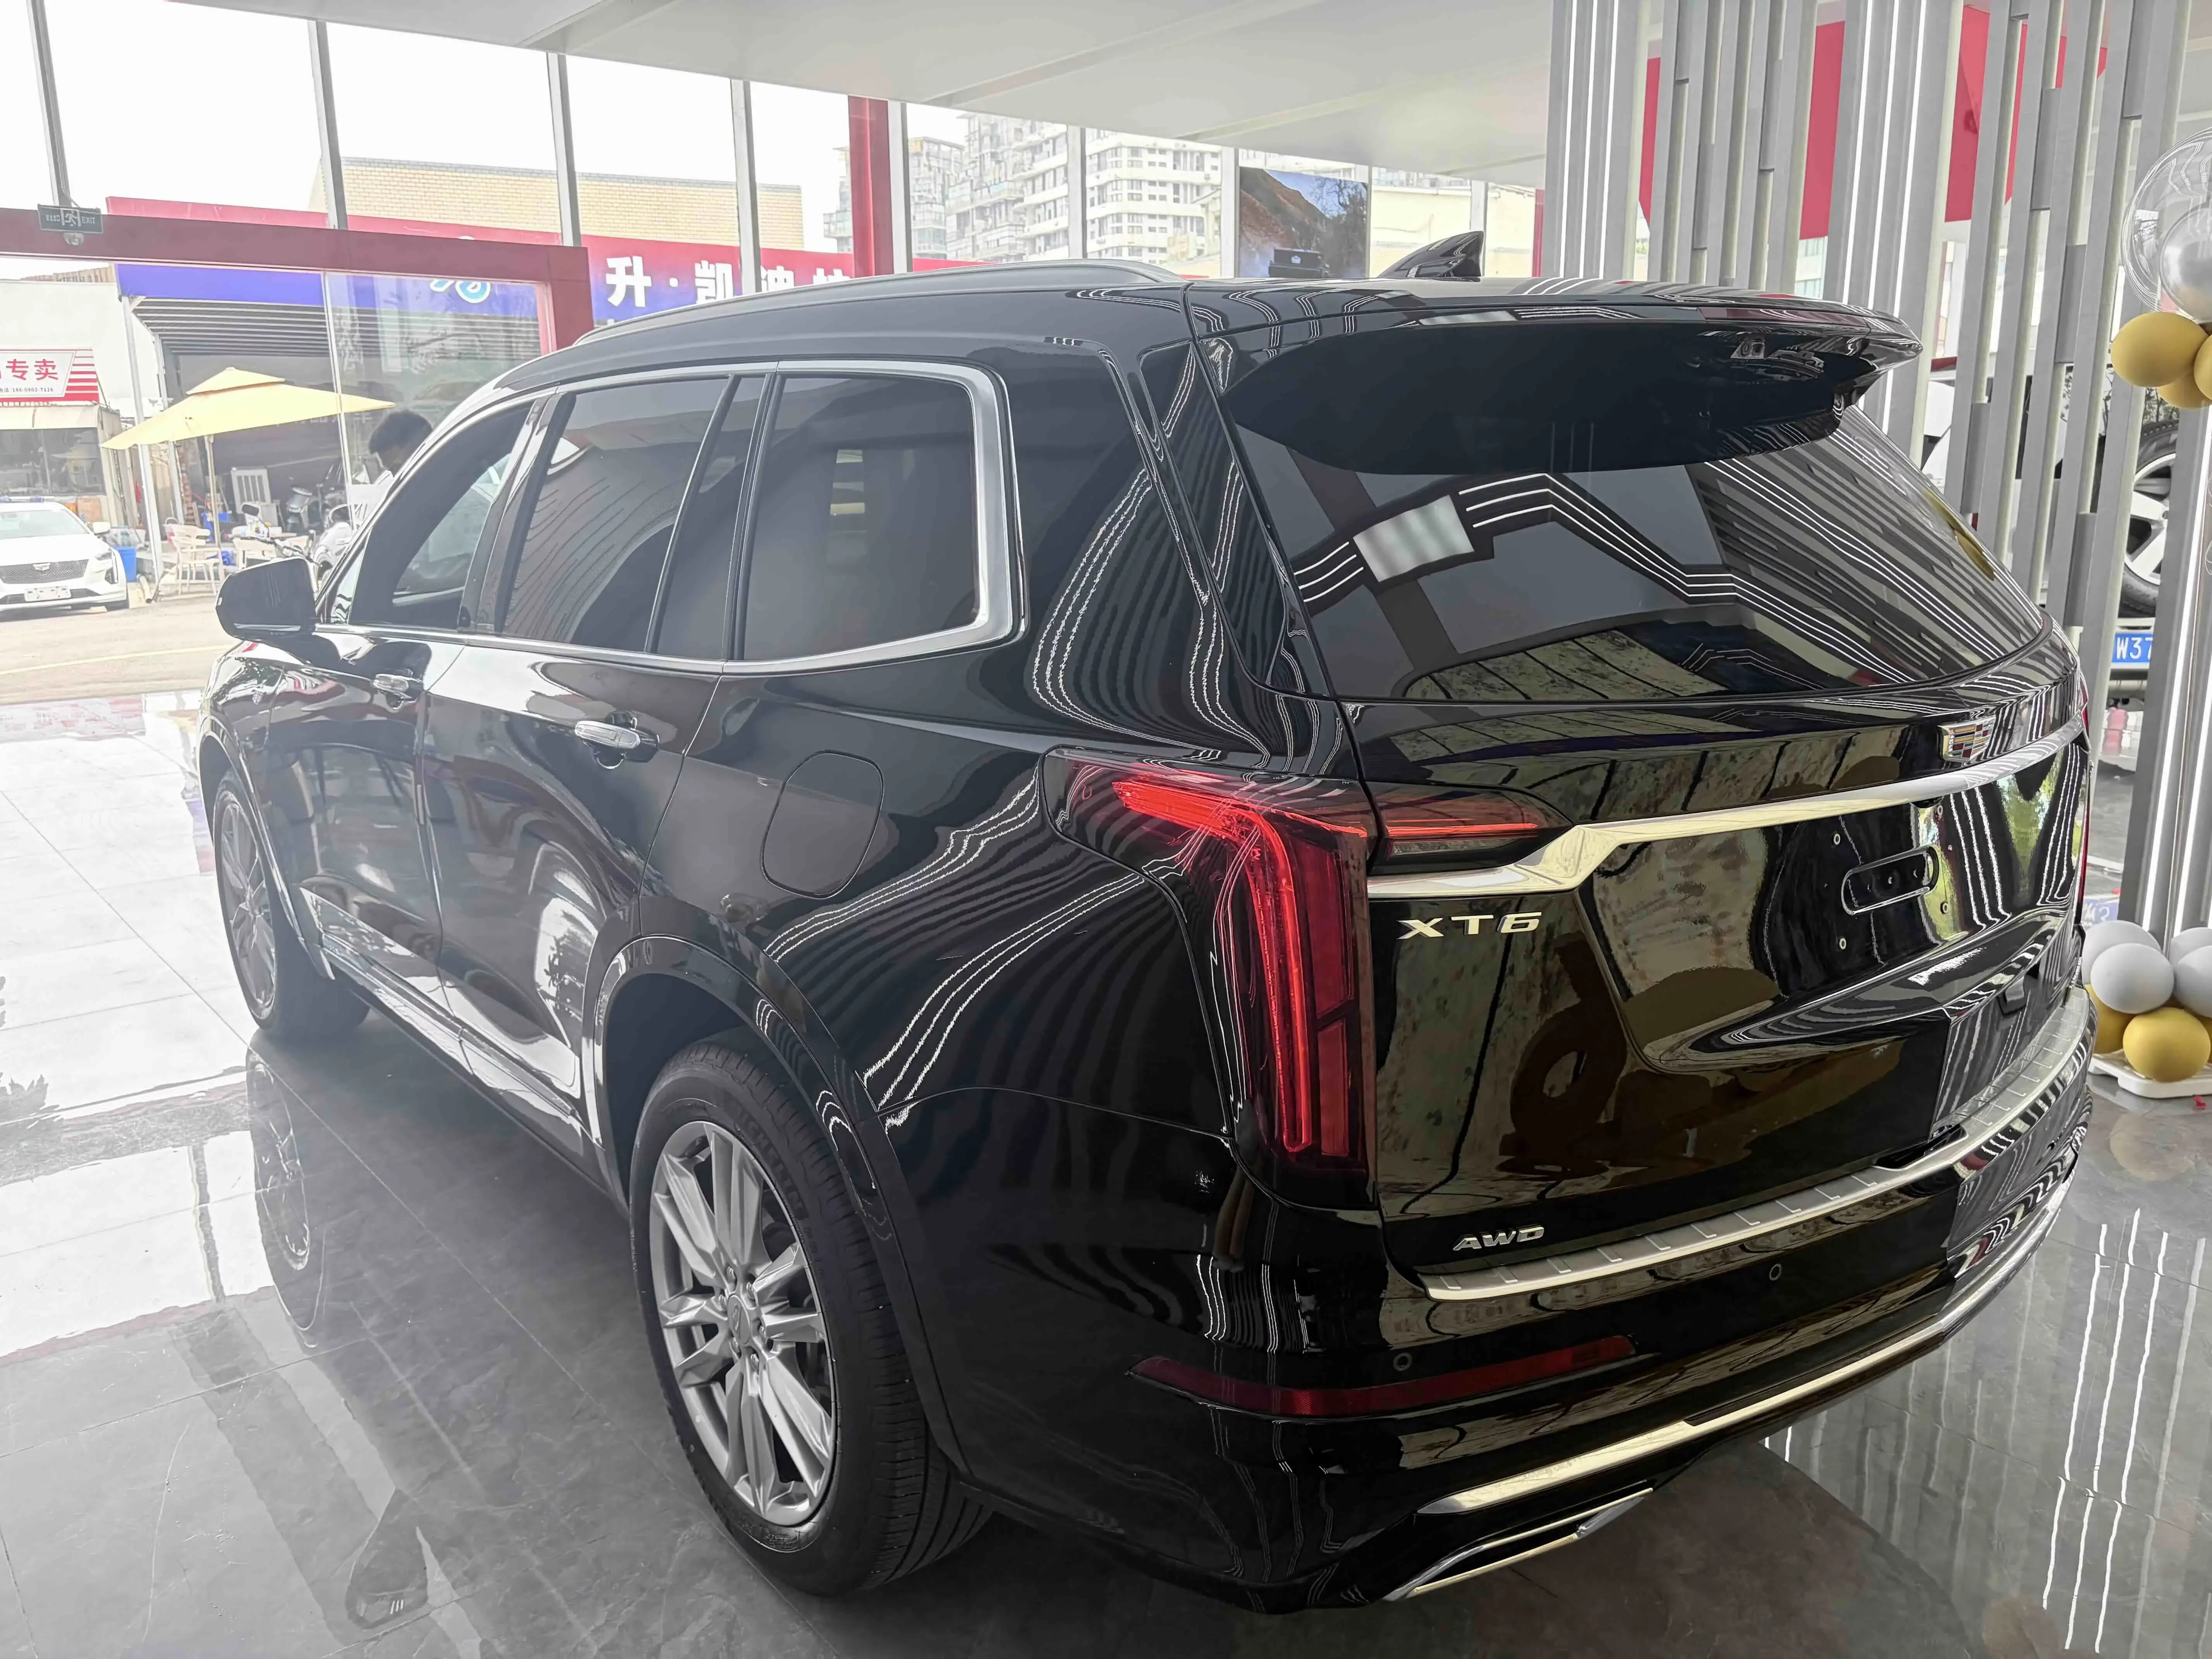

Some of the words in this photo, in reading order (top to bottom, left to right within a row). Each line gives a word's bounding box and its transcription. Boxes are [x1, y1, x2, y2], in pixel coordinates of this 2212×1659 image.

[82, 217, 95, 225] EXIT
[0, 359, 58, 380] 专卖
[1397, 912, 1542, 939] XT6
[1453, 1225, 1544, 1251] AWD
